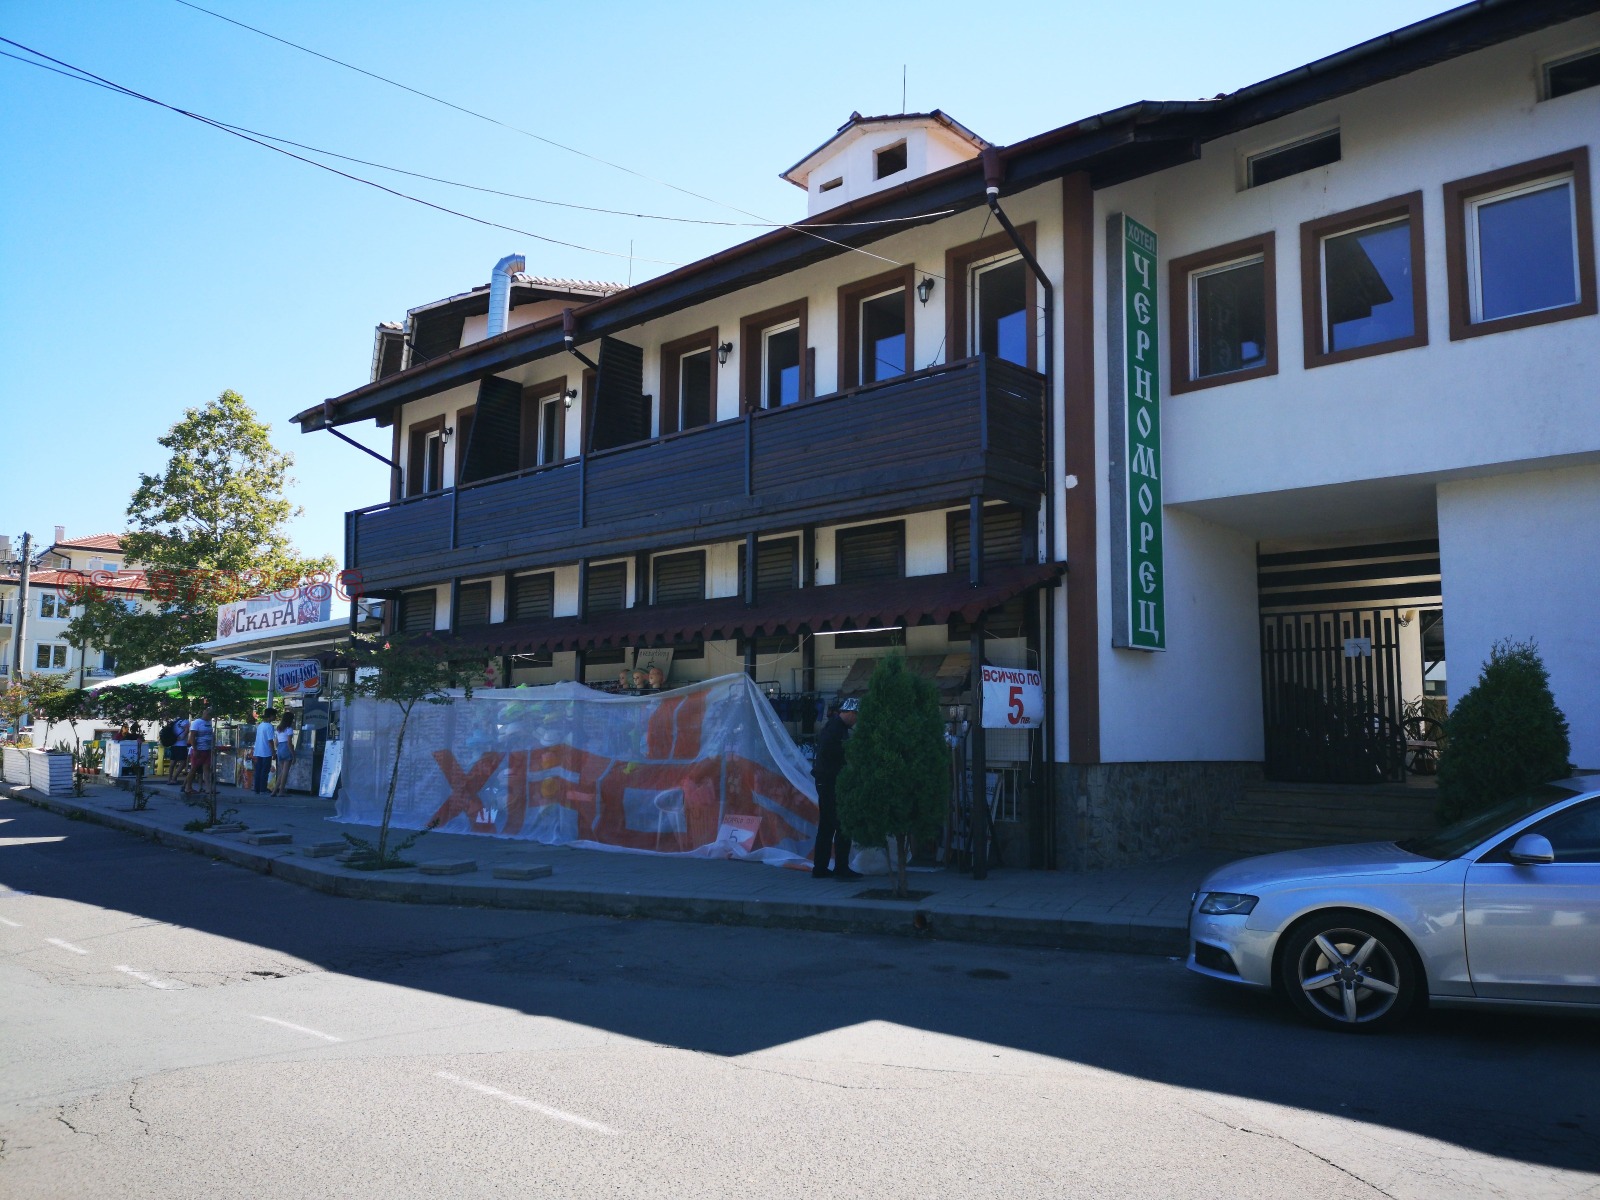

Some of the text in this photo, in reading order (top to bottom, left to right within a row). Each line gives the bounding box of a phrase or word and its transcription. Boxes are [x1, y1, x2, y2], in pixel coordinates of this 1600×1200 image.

[1128, 223, 1155, 252] ХОТЕЛ
[278, 663, 318, 690] SUNGLASSES
[983, 669, 1040, 686] ВСИЧКО ПО
[1007, 686, 1024, 725] 5
